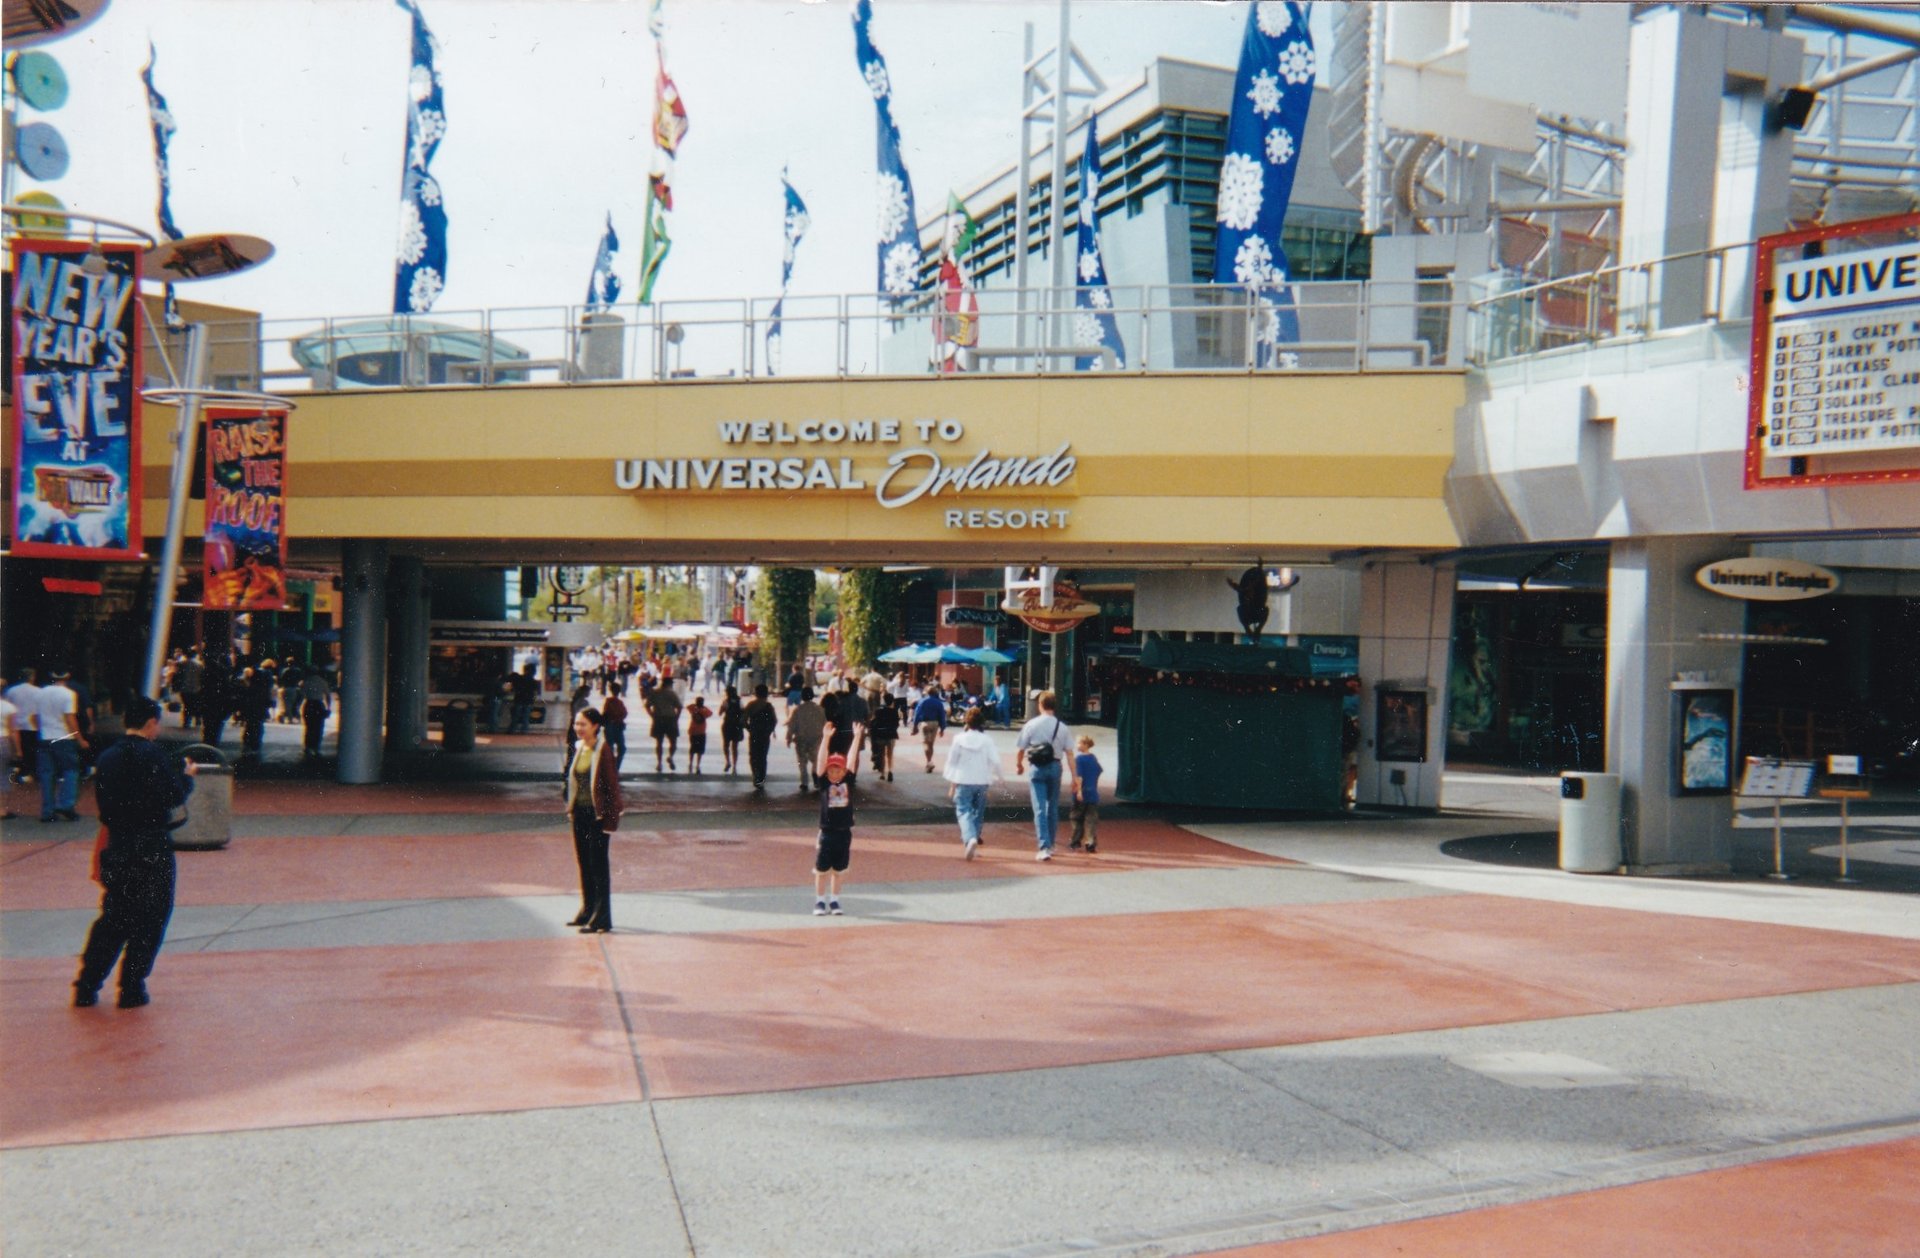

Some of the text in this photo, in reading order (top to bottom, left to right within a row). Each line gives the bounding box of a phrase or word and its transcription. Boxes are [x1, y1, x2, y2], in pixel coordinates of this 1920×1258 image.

[1786, 254, 1919, 303] UNIVE
[17, 251, 134, 327] NEW
[1852, 323, 1900, 340] CRAZY
[17, 319, 128, 370] YEAR'S
[1827, 343, 1874, 358] HARRY
[1826, 358, 1889, 376] JACKASS
[1825, 377, 1868, 393] SANTA
[21, 371, 127, 442] EVE
[1824, 392, 1885, 410] SOLARIS
[1824, 407, 1896, 425] TREASURE
[209, 418, 284, 463] RAISE
[718, 420, 963, 442] WELCOME TO
[1822, 427, 1869, 442] HARRY
[1880, 423, 1920, 437] POTT
[62, 441, 89, 461] AT
[242, 459, 281, 488] THE
[614, 442, 1078, 508] UNIVERSAL Orlando
[211, 486, 284, 533] ROOF
[945, 510, 1069, 528] RESORT
[1709, 569, 1773, 587] Universal
[946, 610, 1006, 623] CINNABON
[1313, 643, 1348, 657] Dining
